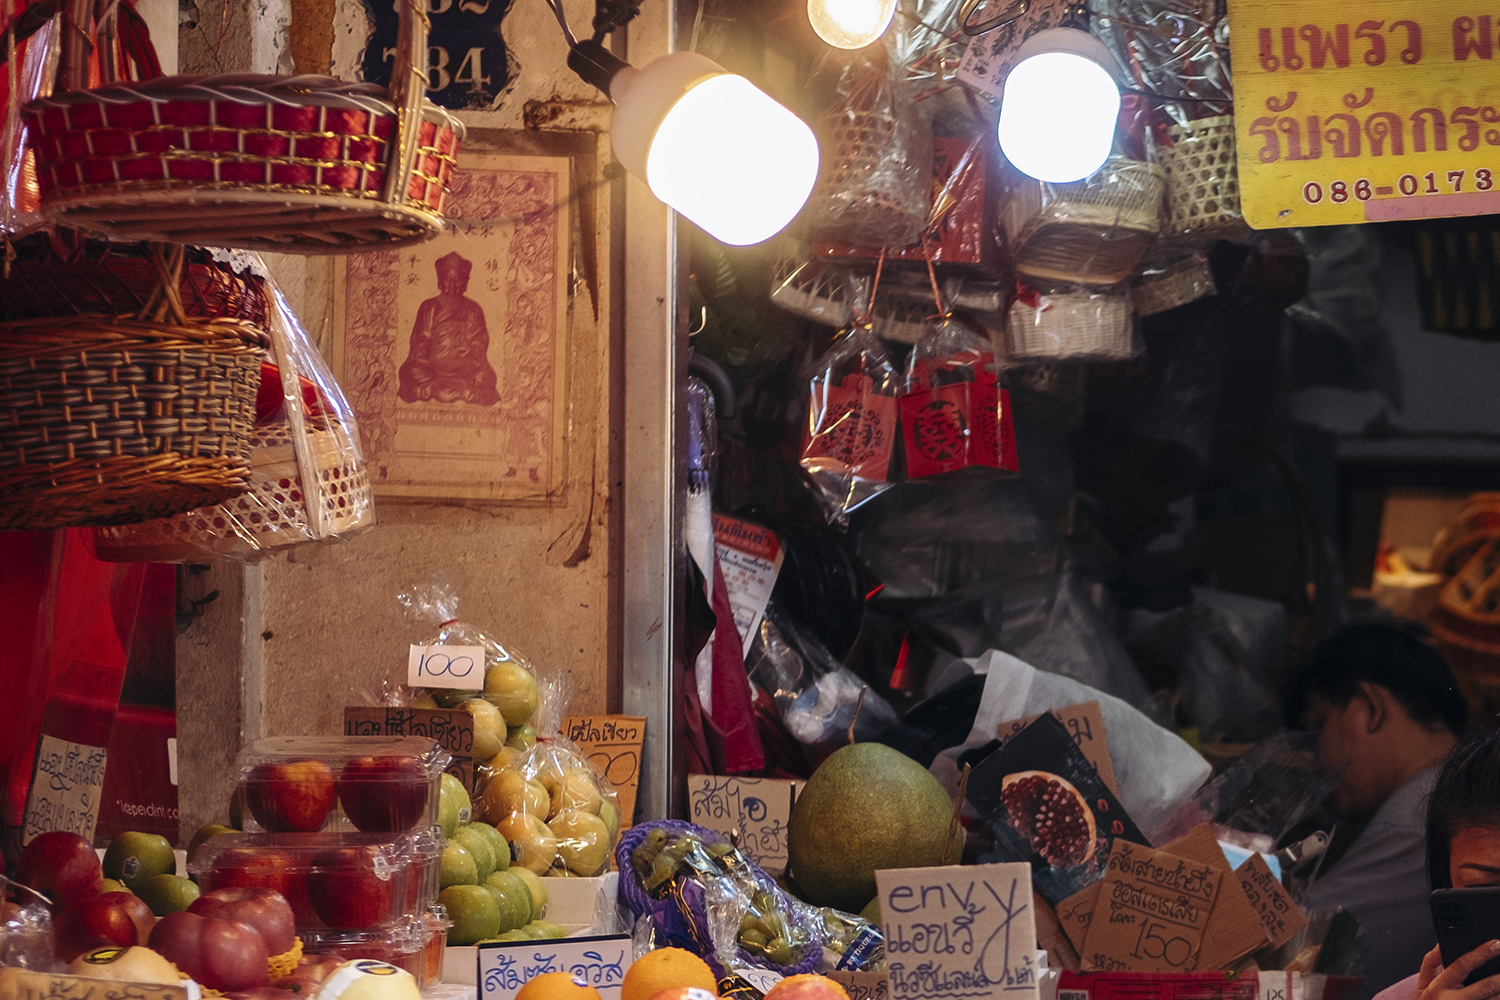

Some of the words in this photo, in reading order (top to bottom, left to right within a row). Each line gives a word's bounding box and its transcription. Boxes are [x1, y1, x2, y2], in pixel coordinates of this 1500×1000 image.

[1257, 19, 1422, 72] แพรว
[382, 45, 491, 95] 84
[418, 652, 474, 678] 100
[692, 777, 768, 823] ส้มโอ
